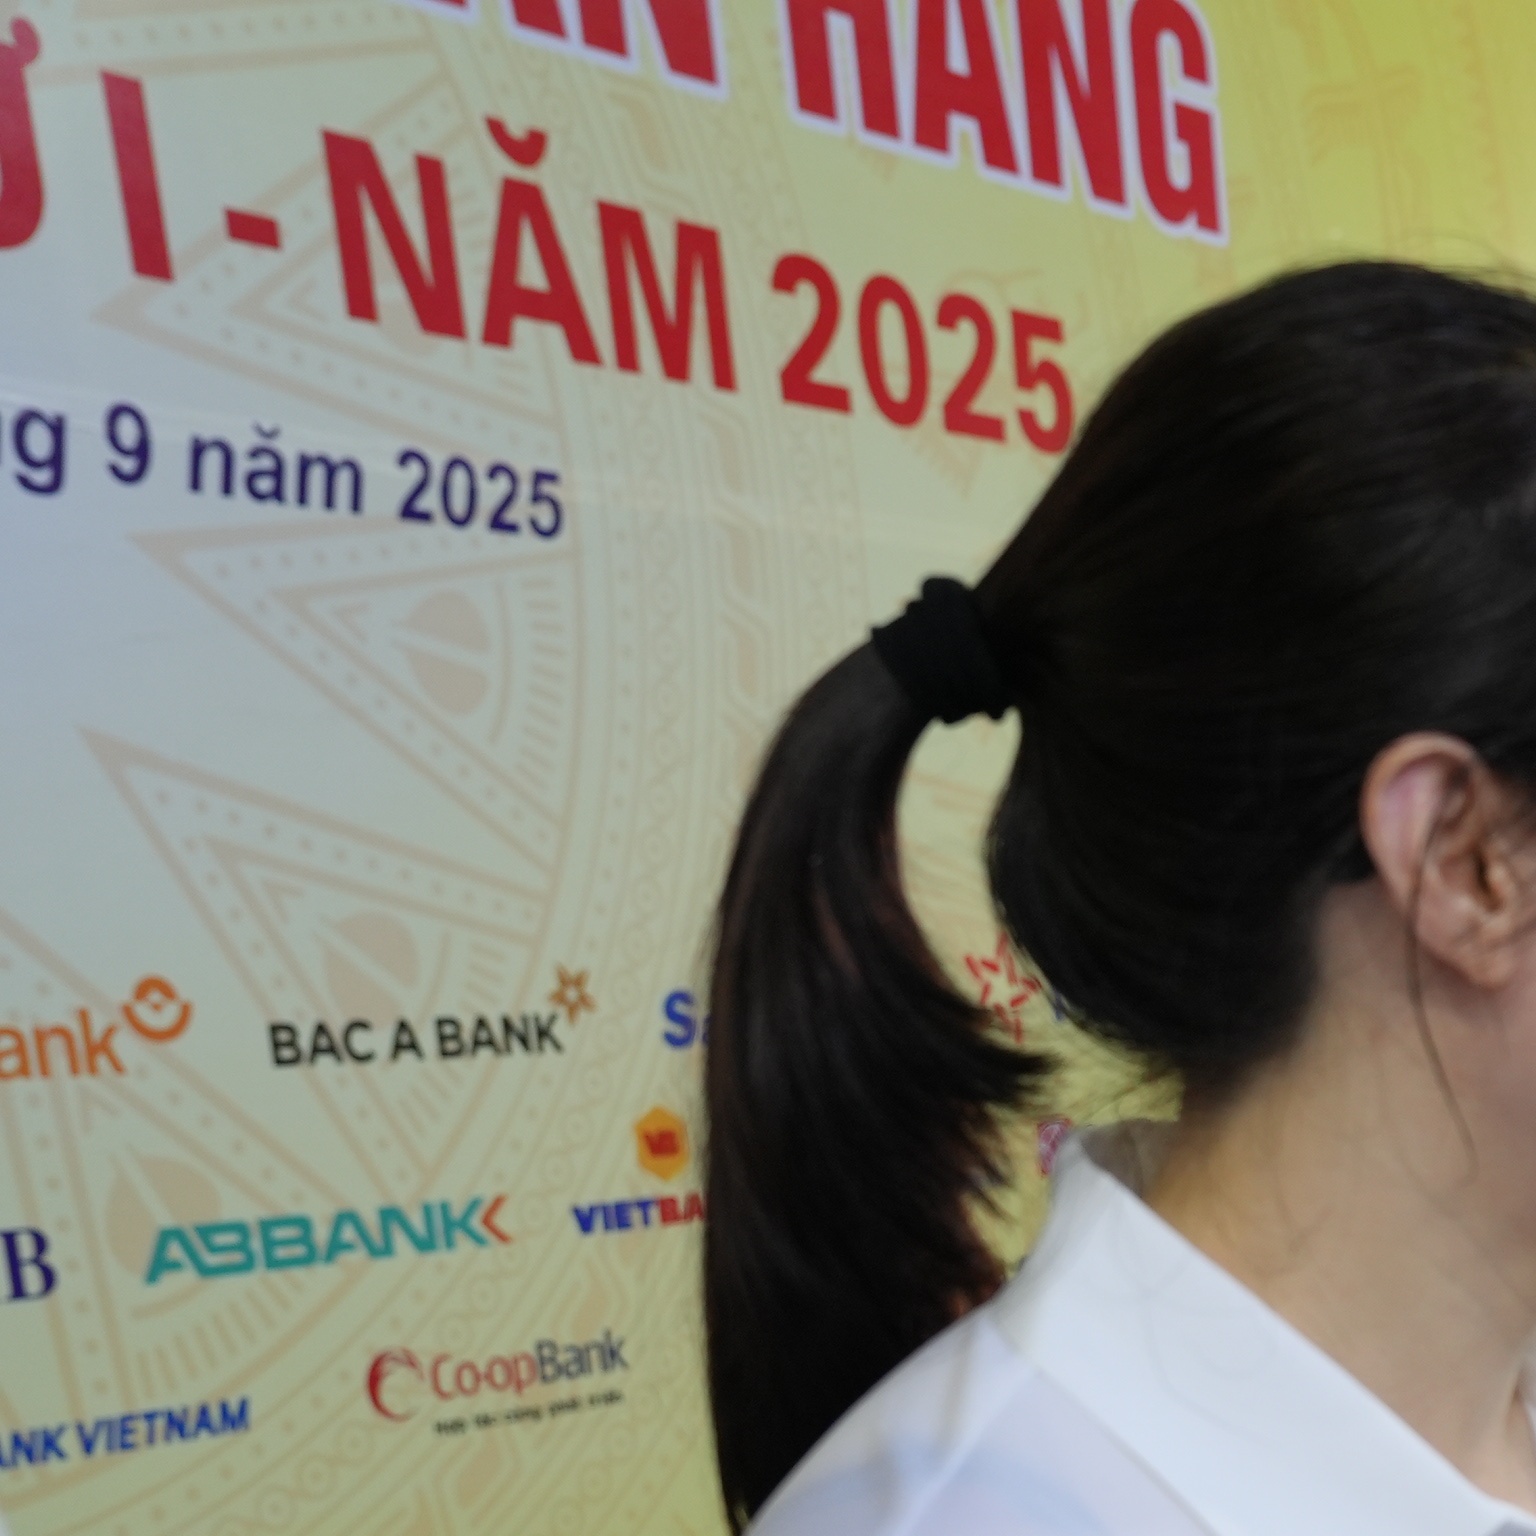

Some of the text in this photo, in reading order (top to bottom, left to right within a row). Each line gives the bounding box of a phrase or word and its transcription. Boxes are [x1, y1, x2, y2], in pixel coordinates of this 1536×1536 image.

[320, 115, 738, 392] NĂM
[770, 253, 1075, 456] 2025
[106, 403, 152, 484] 9
[188, 423, 364, 515] năm
[397, 448, 564, 539] 2025
[270, 1010, 565, 1067] BAC A BANK
[75, 1395, 253, 1458] VIETNAM
